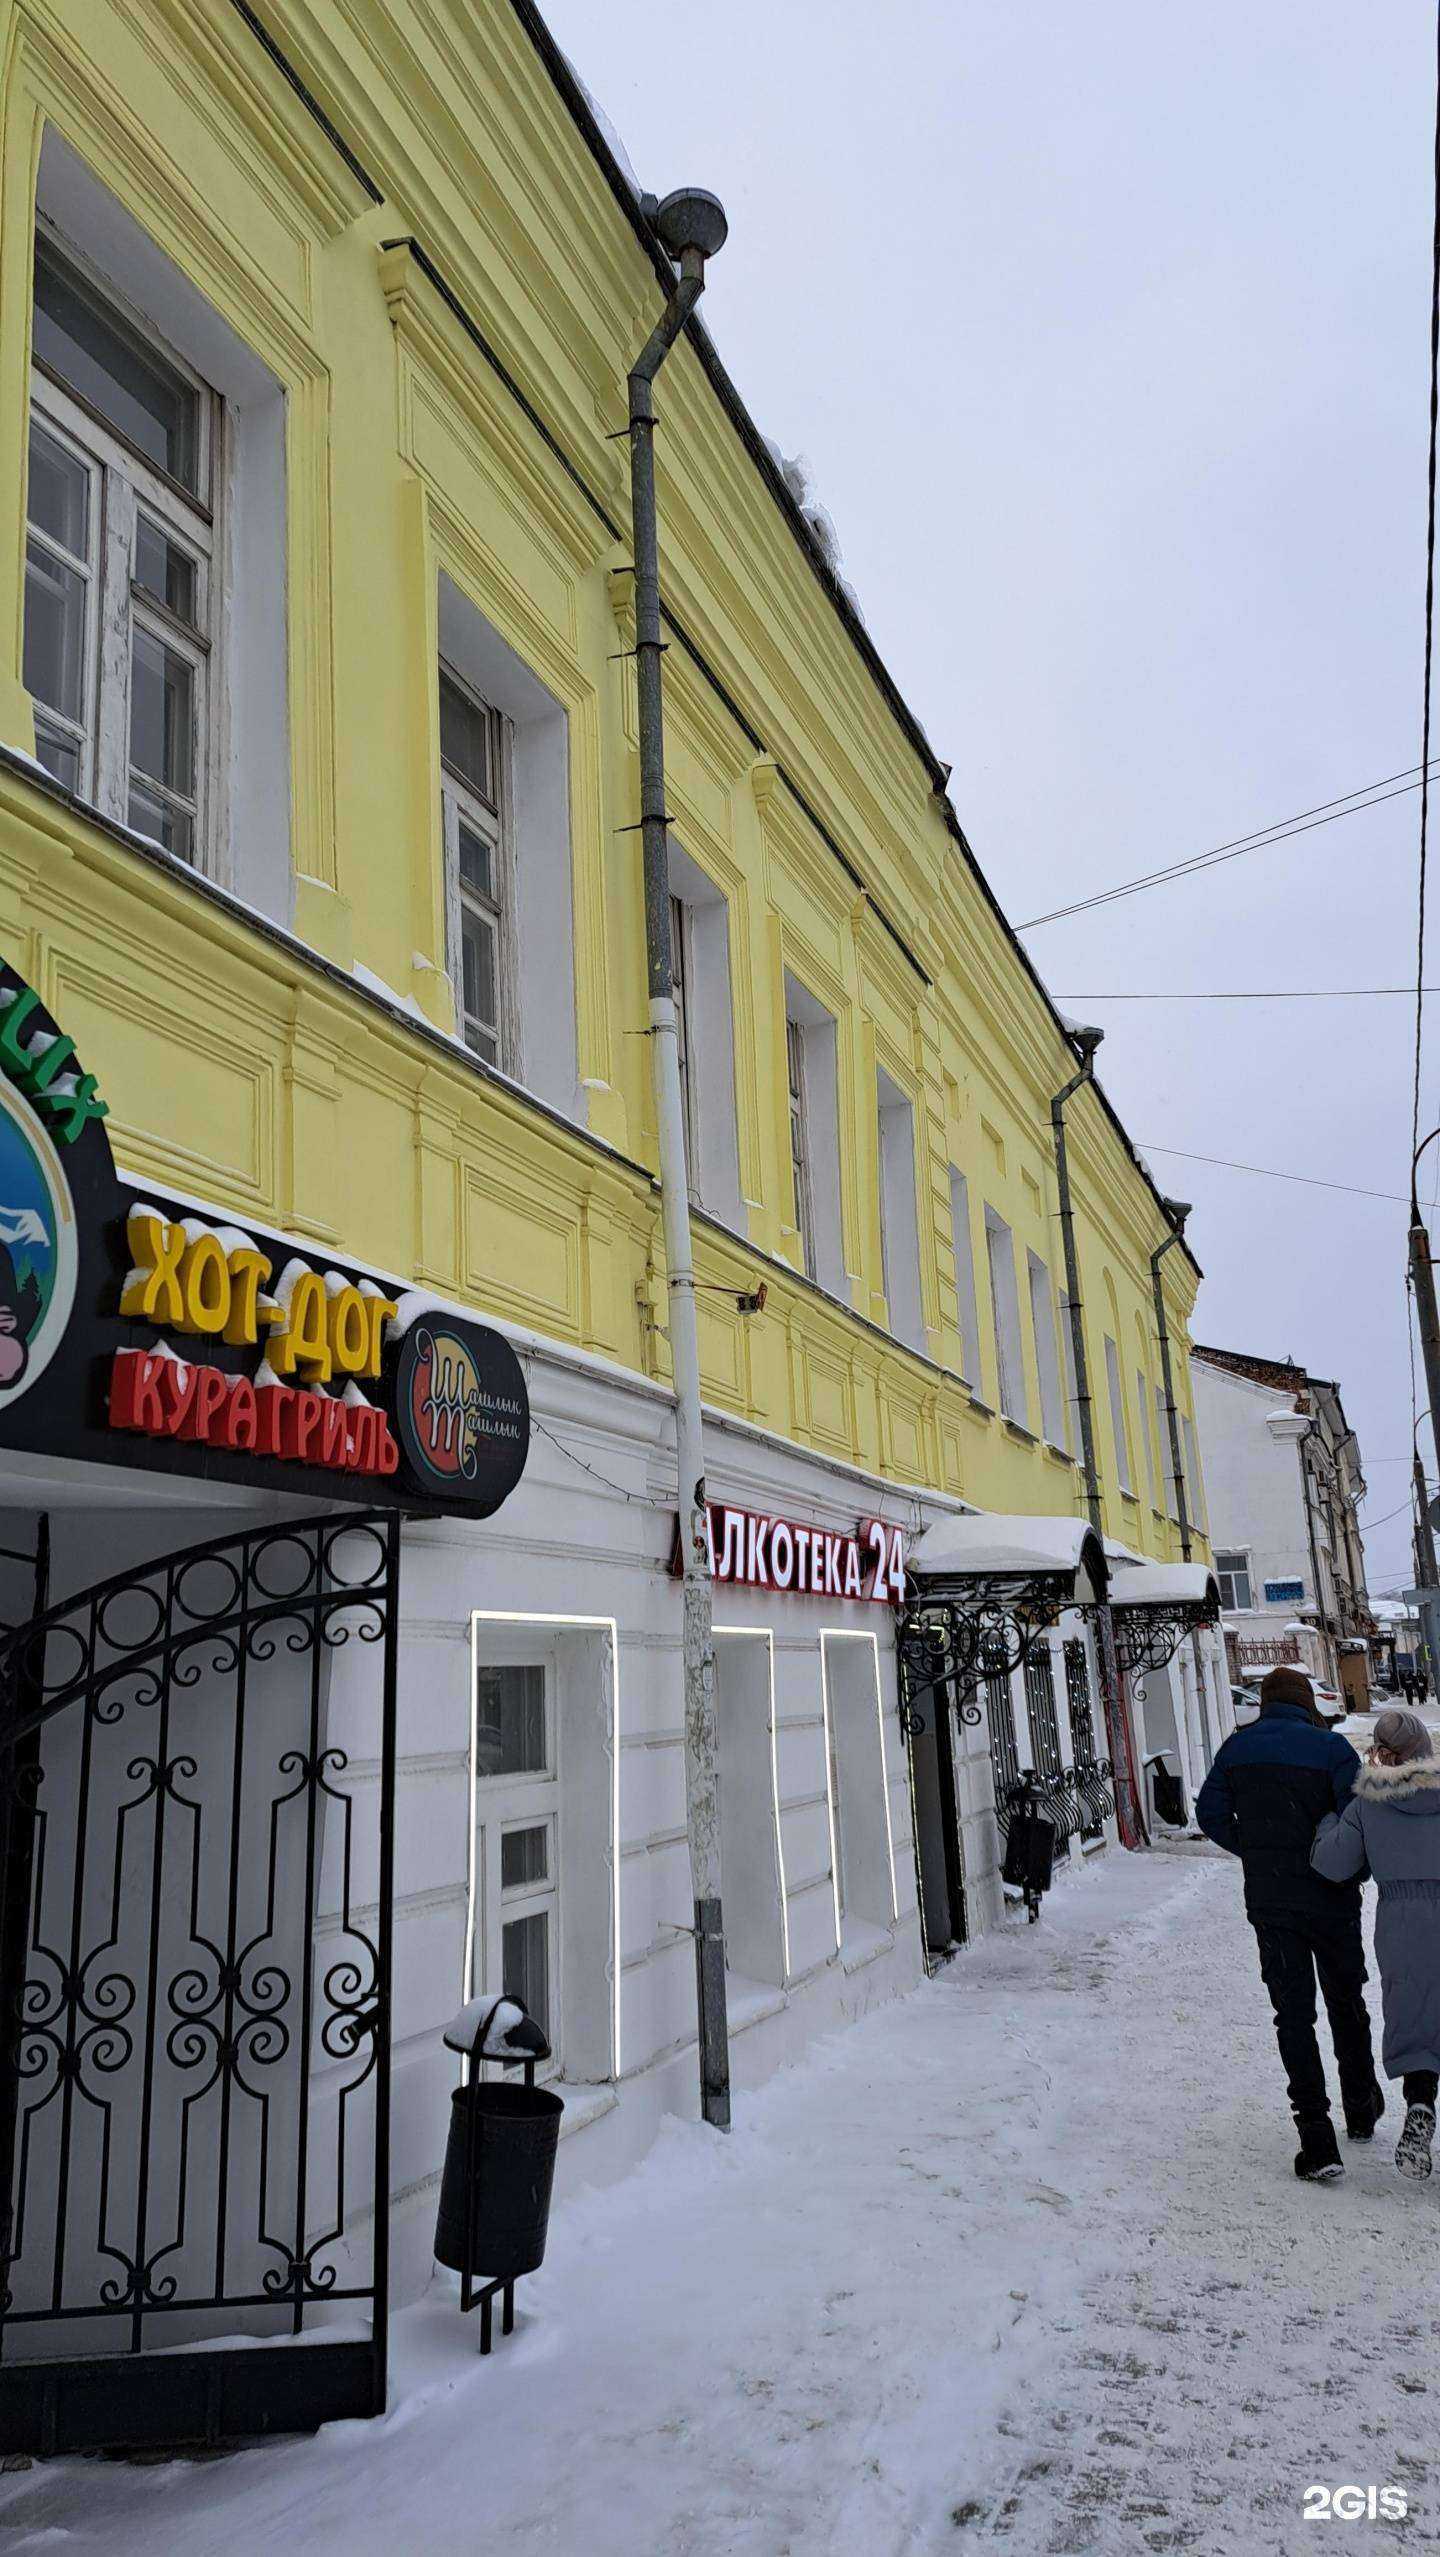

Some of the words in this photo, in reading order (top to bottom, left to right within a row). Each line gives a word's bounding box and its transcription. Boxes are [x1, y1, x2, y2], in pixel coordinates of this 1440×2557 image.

[120, 1215, 399, 1384] ХОТ-ДОГ
[110, 1350, 258, 1449] КУРА
[257, 1382, 400, 1475] ГРИЛЬ
[869, 1521, 906, 1603] 24
